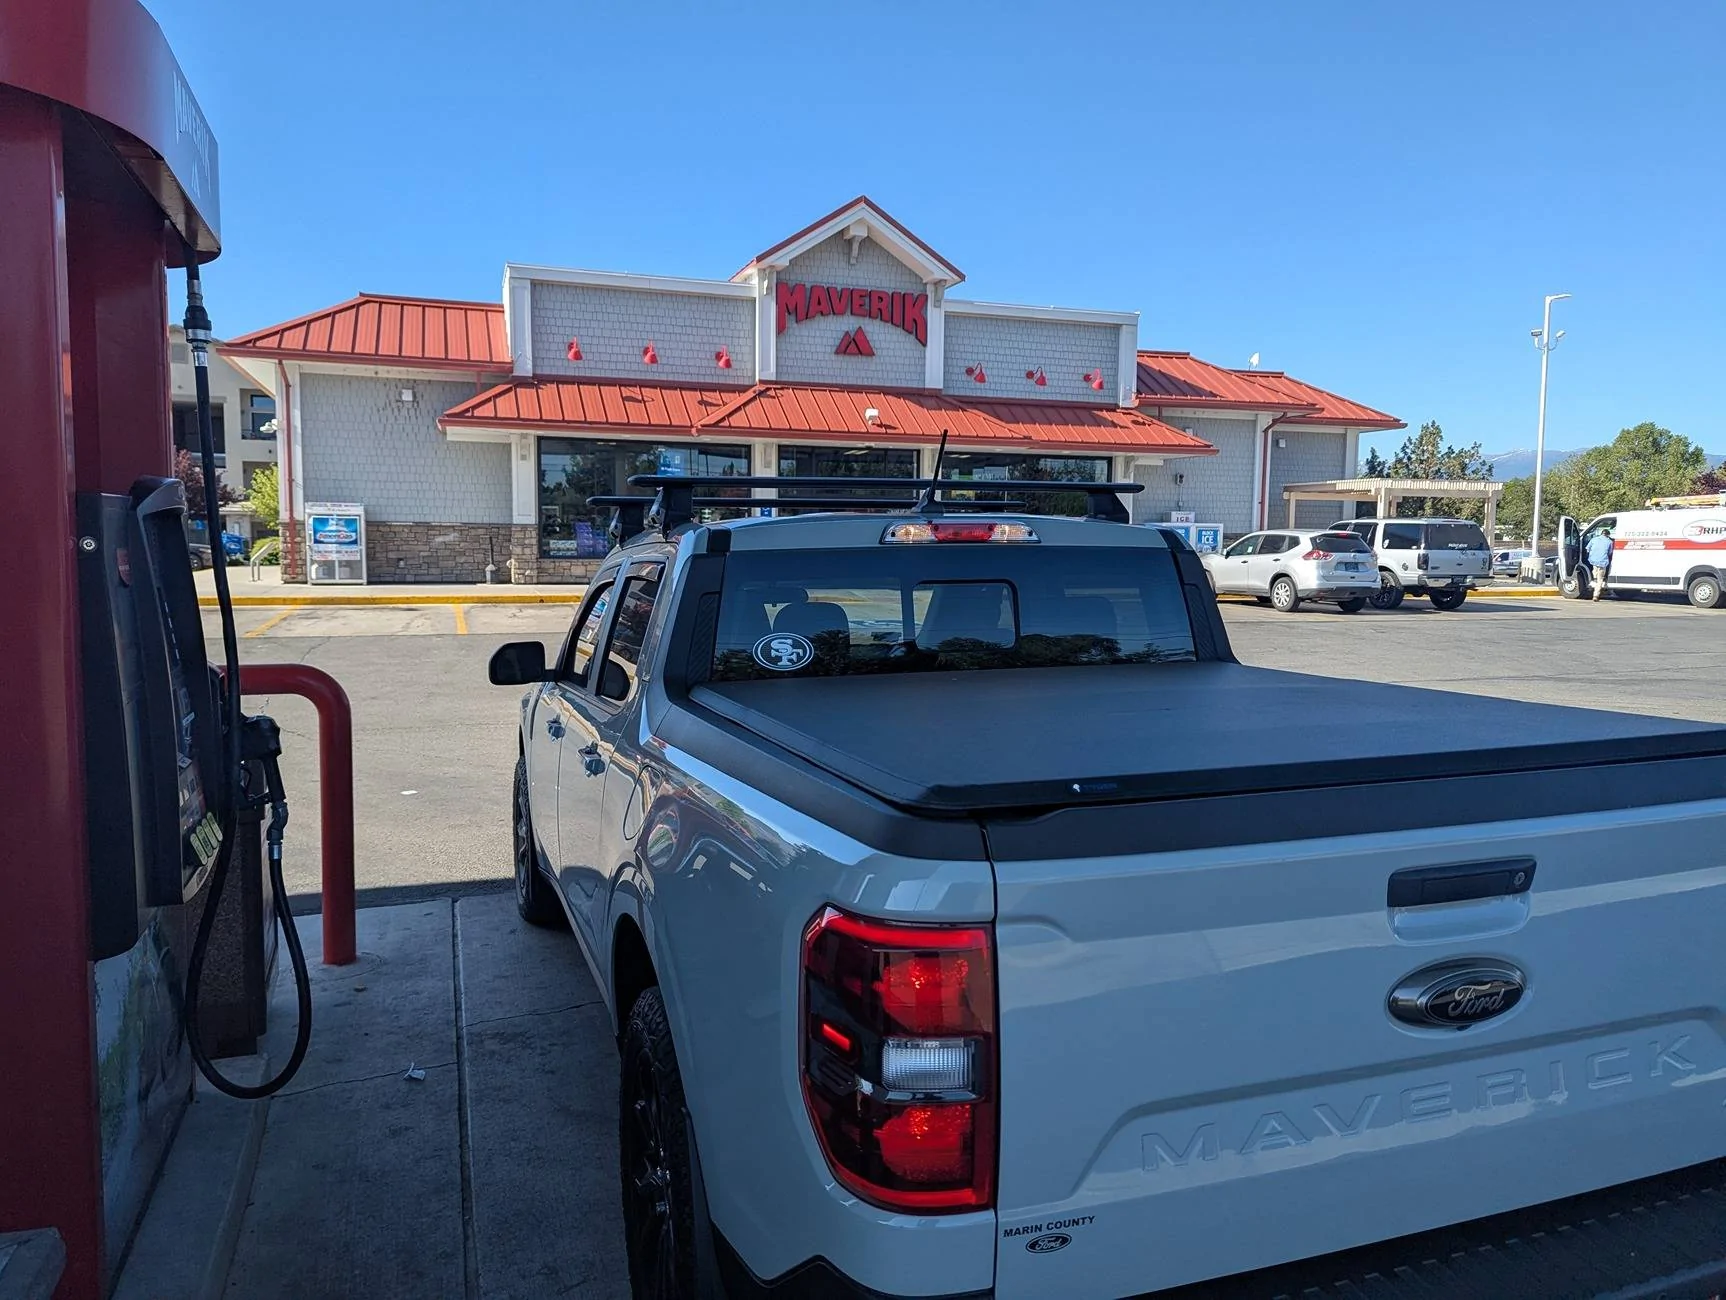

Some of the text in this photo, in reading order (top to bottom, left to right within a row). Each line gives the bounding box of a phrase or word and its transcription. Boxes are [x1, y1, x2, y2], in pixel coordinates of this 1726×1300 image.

[776, 281, 928, 347] MAVERIK
[1201, 535, 1214, 544] ICE
[1448, 983, 1505, 1017] Ford
[1141, 1034, 1697, 1173] MAVERICK
[1003, 1215, 1096, 1238] MARIN COUNTY
